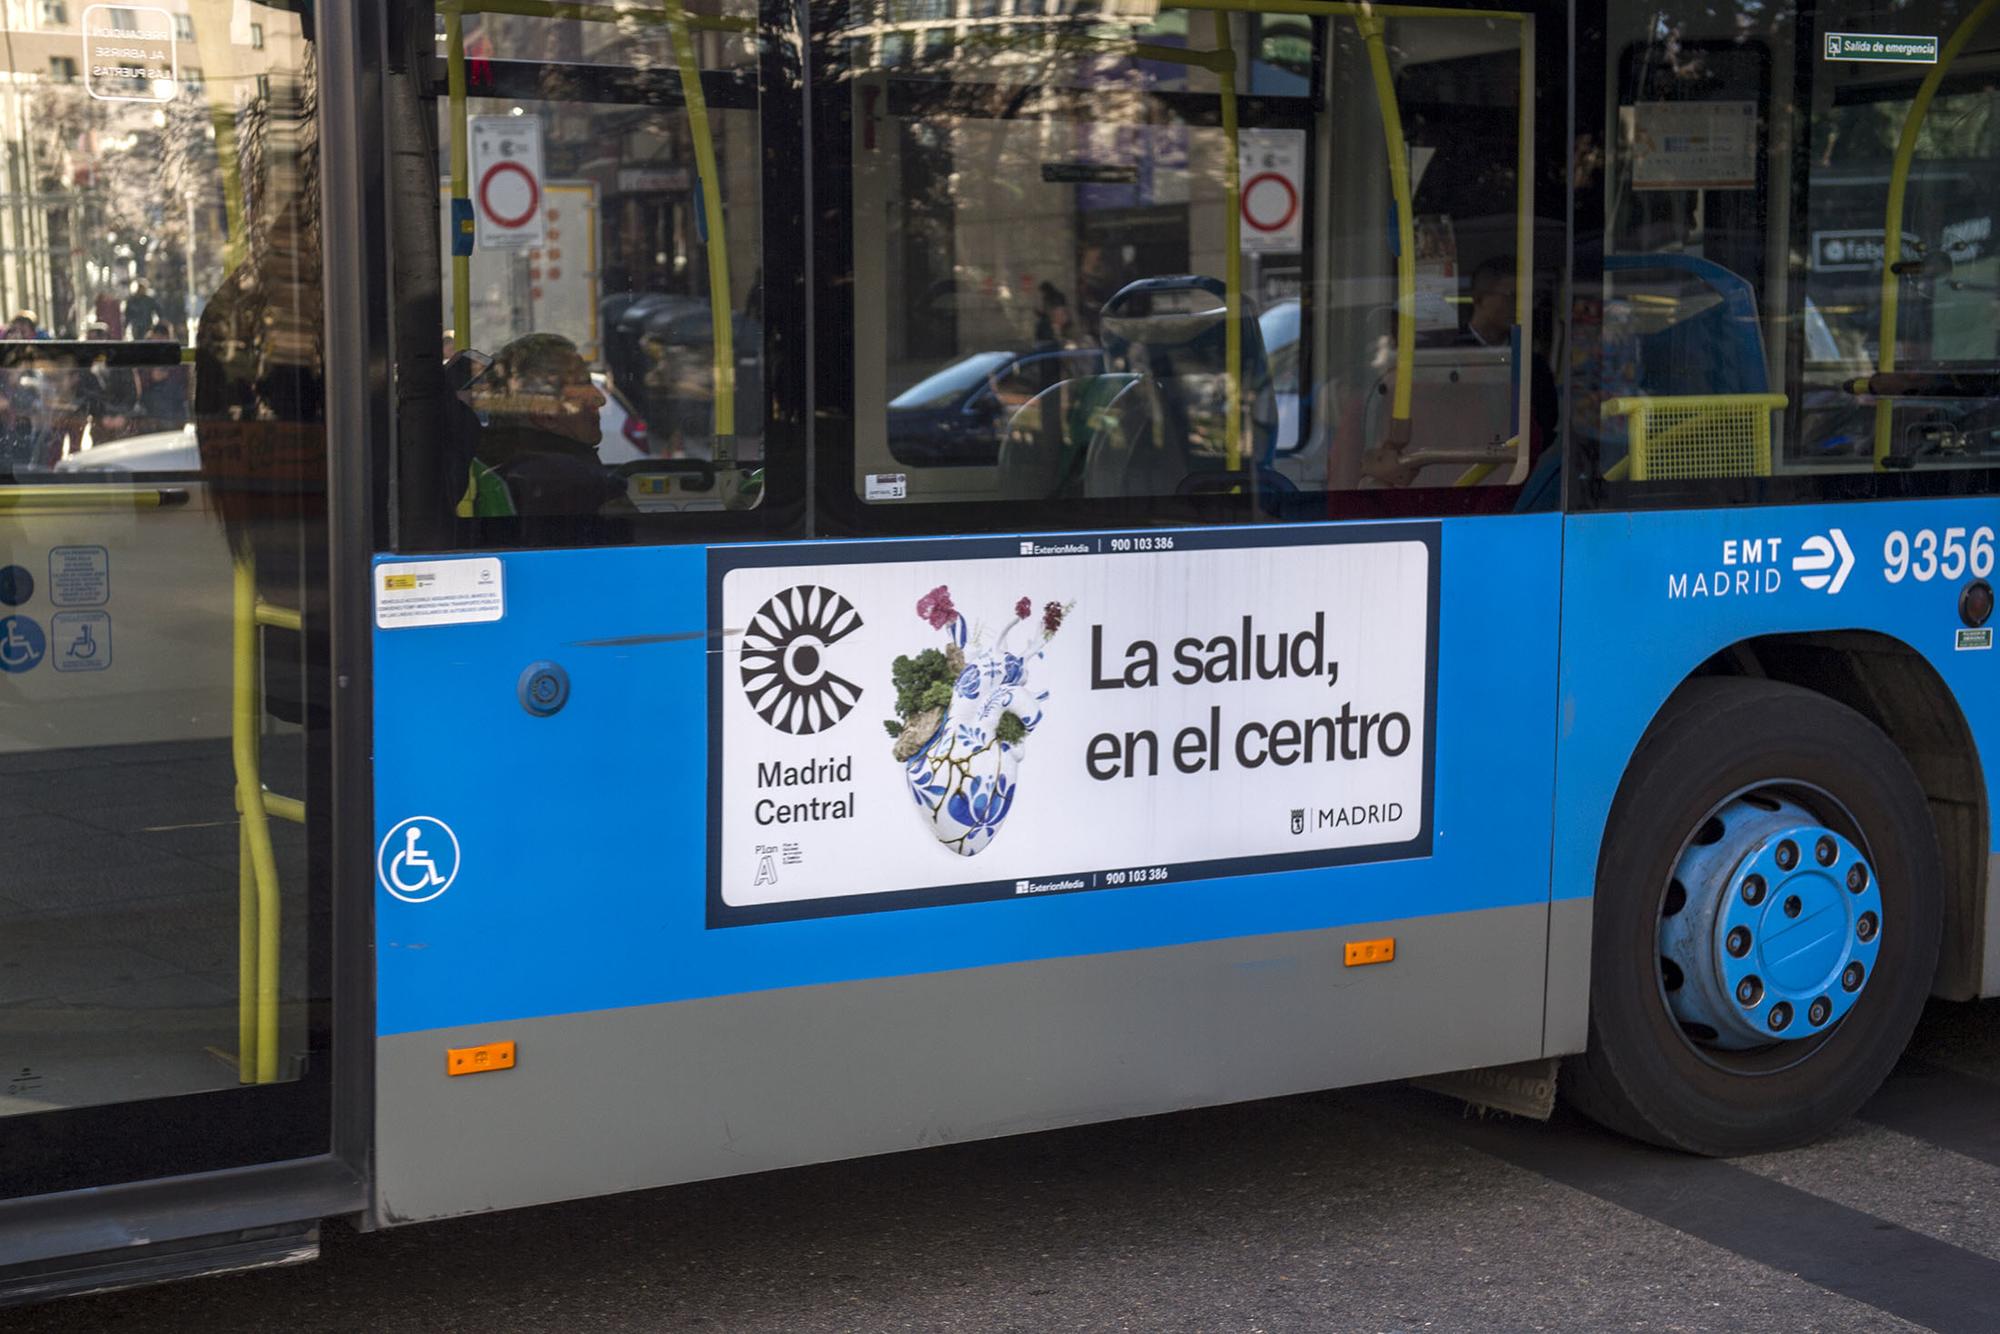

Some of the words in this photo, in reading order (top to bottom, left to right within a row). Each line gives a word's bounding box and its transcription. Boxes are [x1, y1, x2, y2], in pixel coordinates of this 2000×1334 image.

[1844, 40, 1871, 52] Salida
[1872, 41, 1884, 52] de
[1885, 43, 1935, 56] emergencia
[1034, 543, 1089, 555] ExterionMedia
[1111, 539, 1131, 551] 900
[1134, 538, 1152, 550] 103
[1154, 537, 1174, 550] 386
[1723, 537, 1782, 565] EMT
[1884, 526, 1995, 584] 9356
[1668, 568, 1782, 599] MADRID
[1090, 624, 1158, 690] La
[1172, 611, 1339, 687] salud,
[1086, 729, 1158, 781] en
[1173, 706, 1221, 774] el
[1234, 701, 1412, 767] centro
[757, 755, 851, 788] Madrid
[755, 792, 854, 826] Central
[1318, 803, 1403, 830] MADRID
[755, 845, 778, 854] Plan
[753, 855, 778, 887] A
[1029, 880, 1085, 893] ExterionMedia
[1106, 873, 1126, 885] 900
[1129, 870, 1147, 883] 103
[1148, 867, 1169, 880] 386
